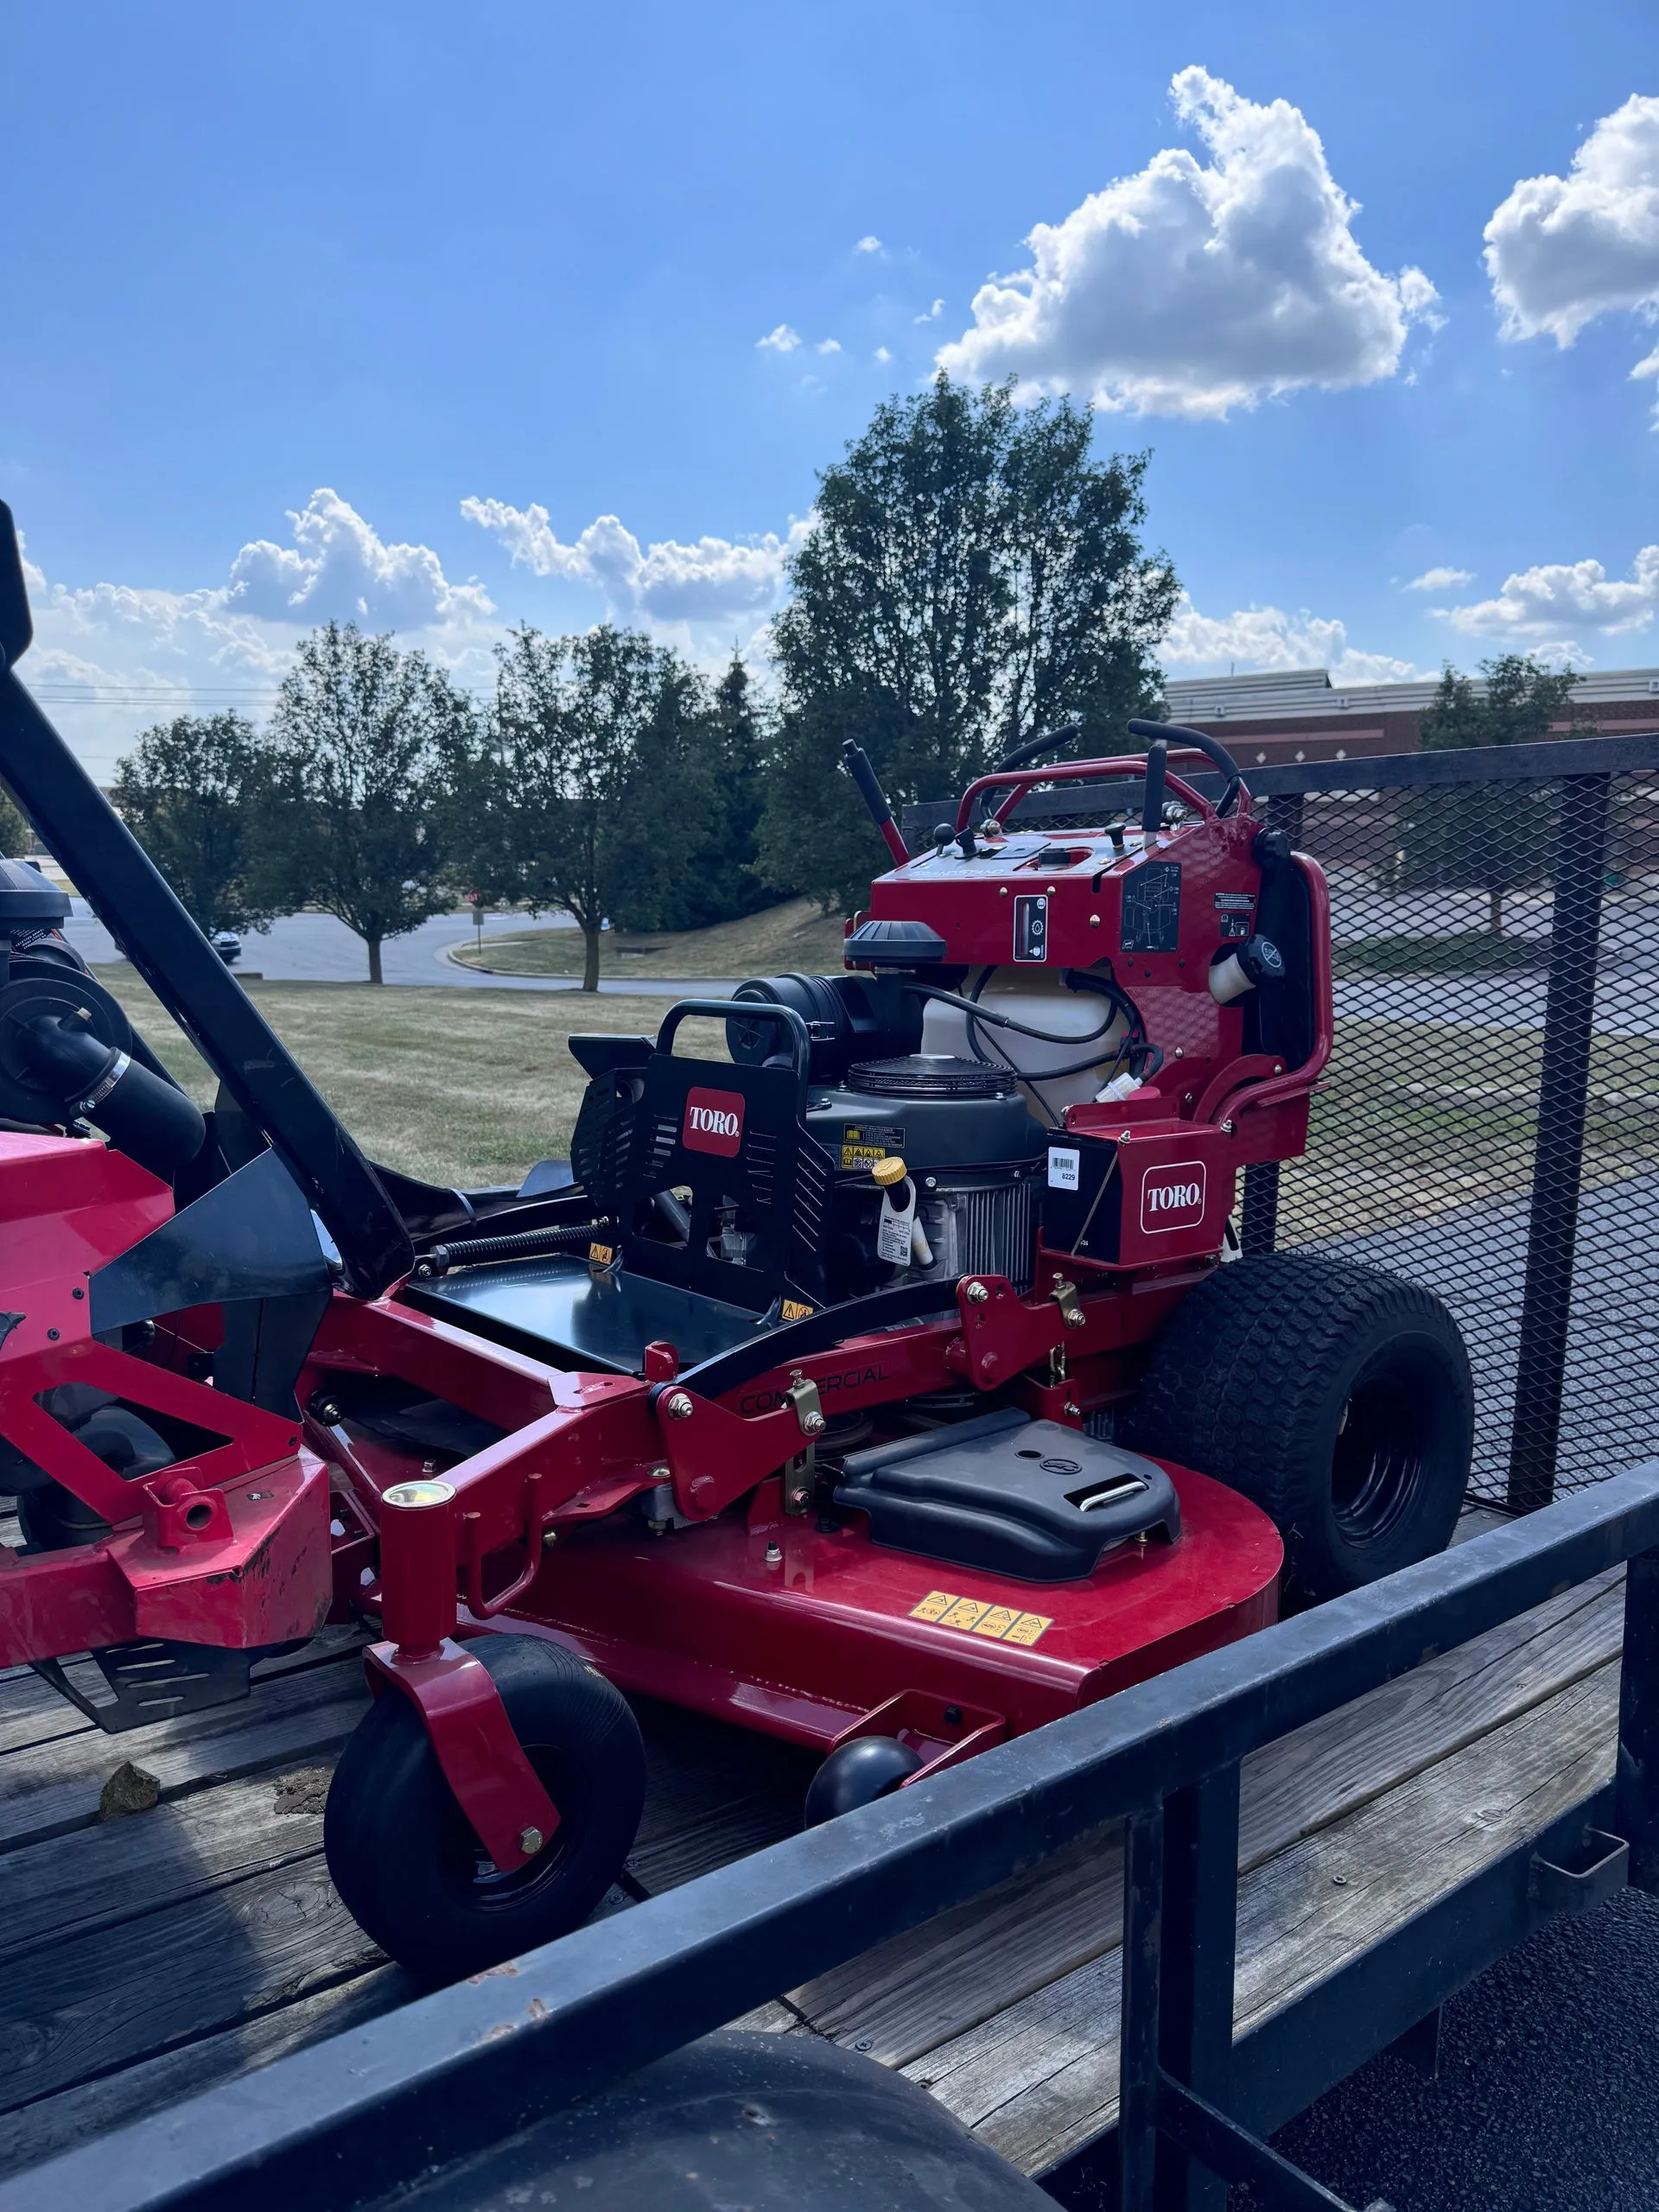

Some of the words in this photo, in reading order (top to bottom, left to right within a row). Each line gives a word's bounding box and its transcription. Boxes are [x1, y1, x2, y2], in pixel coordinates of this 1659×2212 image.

[690, 1106, 739, 1136] TORO
[1061, 1173, 1076, 1181] 8229
[1147, 1182, 1200, 1212] TORO
